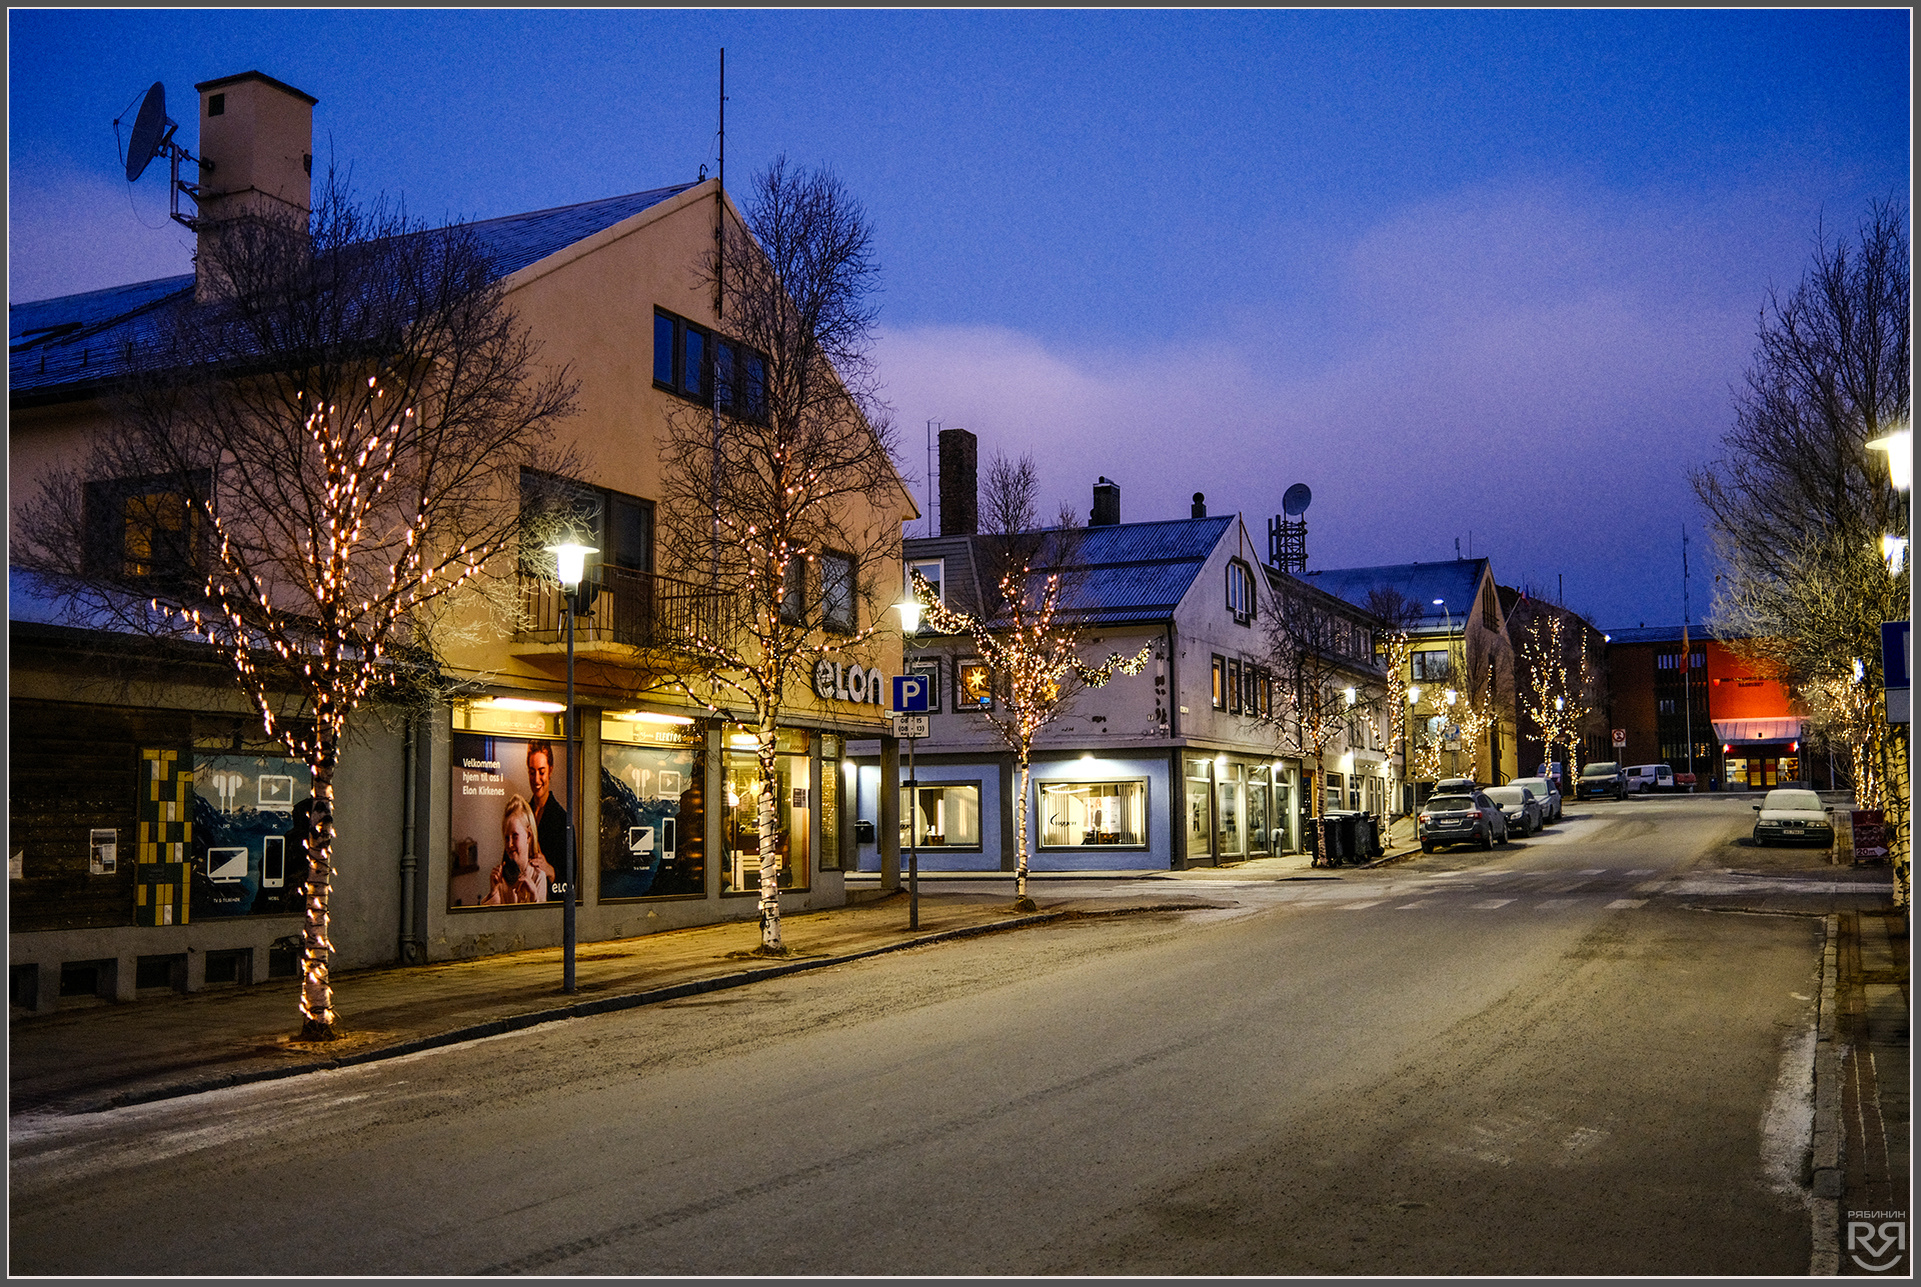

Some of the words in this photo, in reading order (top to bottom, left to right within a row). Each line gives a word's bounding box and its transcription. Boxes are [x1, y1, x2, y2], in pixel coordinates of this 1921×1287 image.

[902, 681, 920, 707] P
[463, 758, 501, 769] Velkommen
[463, 771, 480, 784] hjem
[489, 774, 500, 782] oss
[463, 785, 477, 795] Elon
[479, 786, 505, 796] Kirkenes
